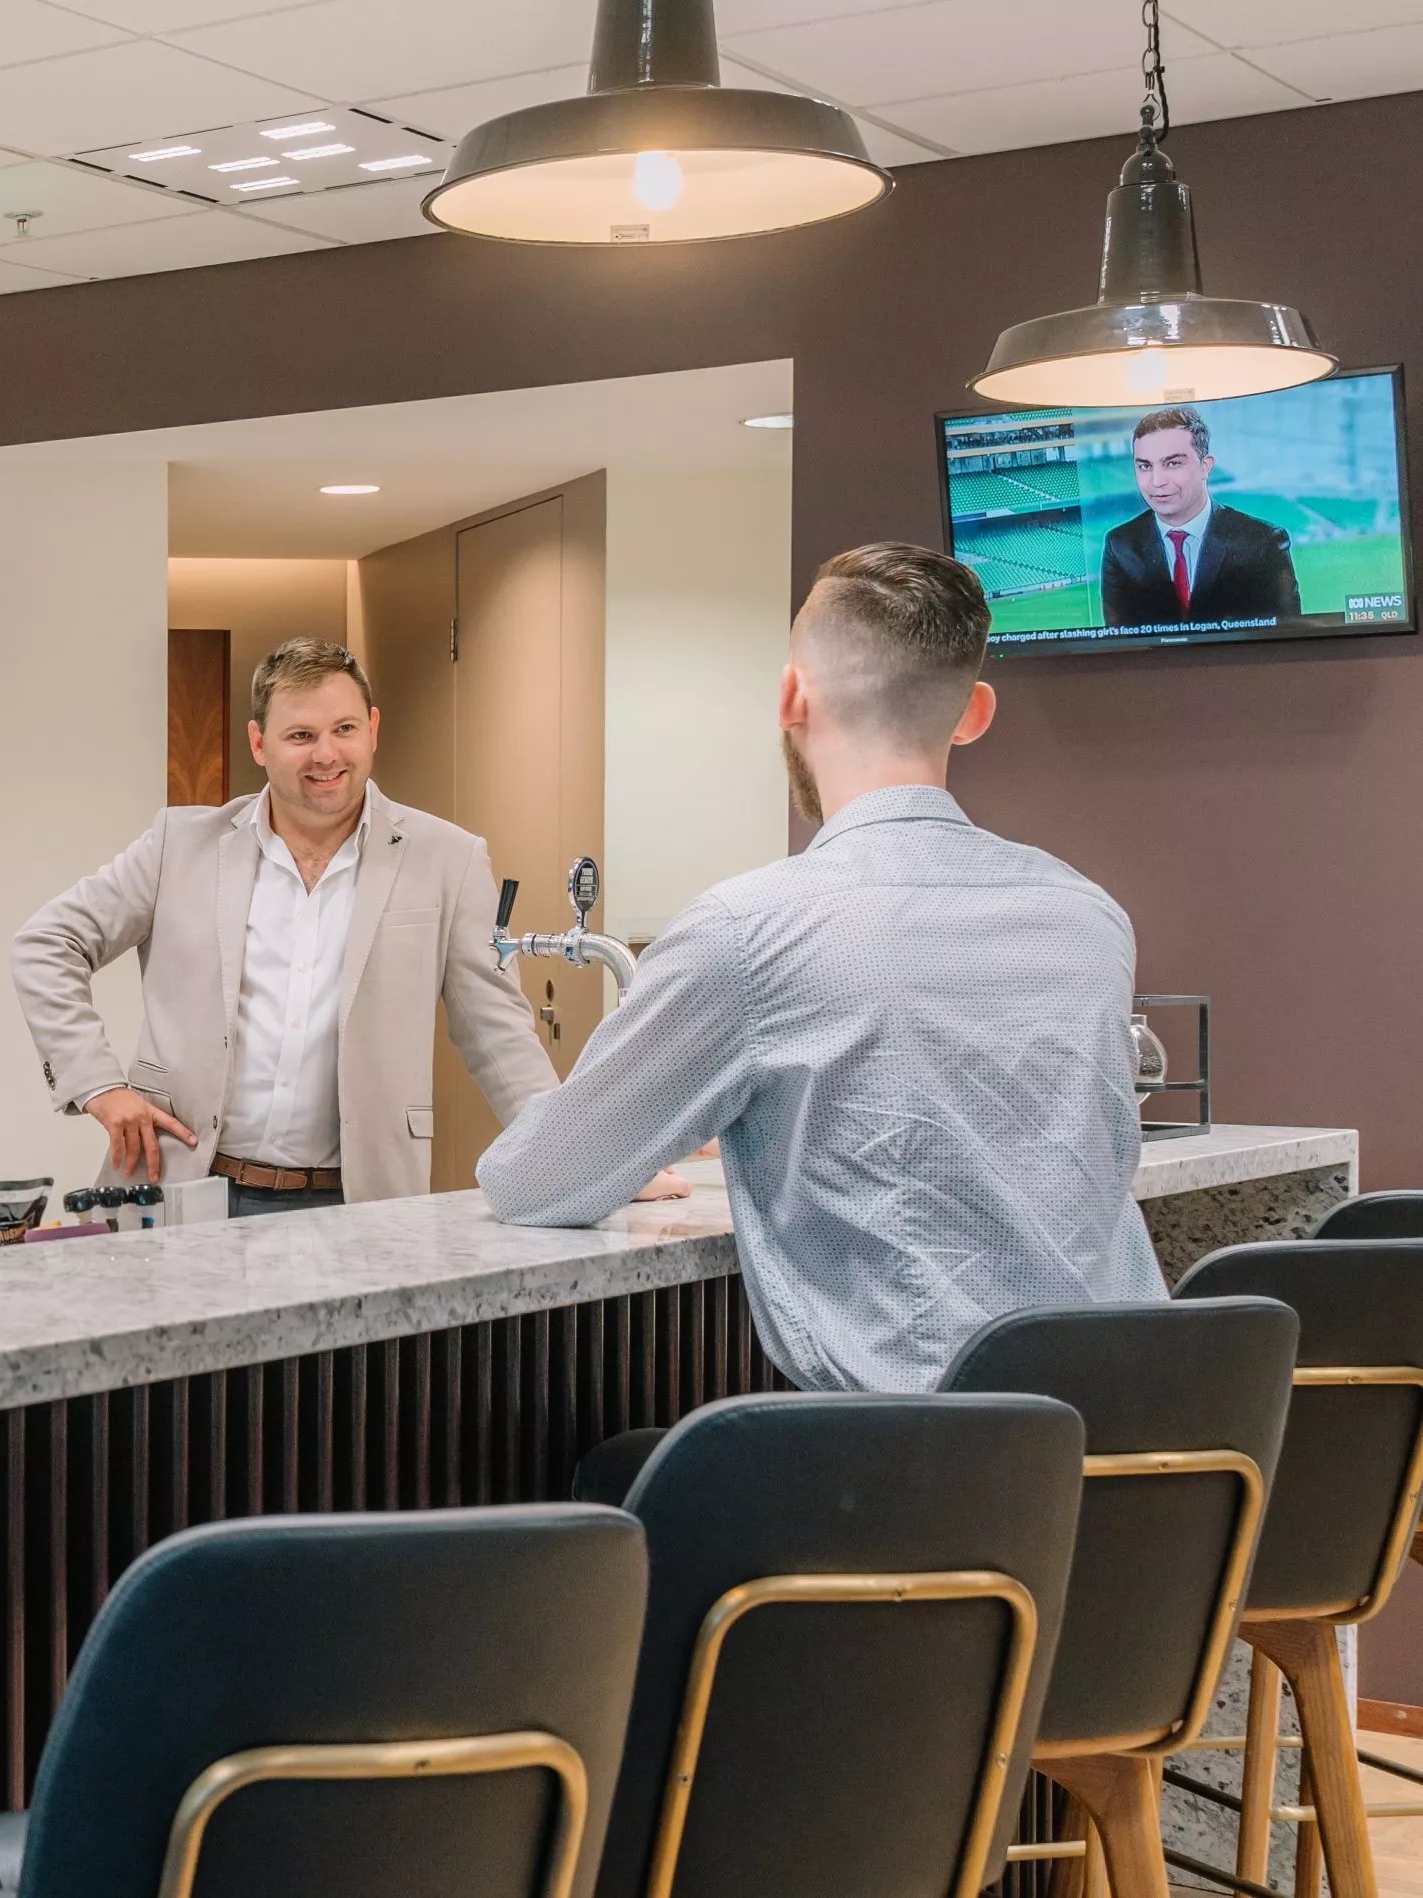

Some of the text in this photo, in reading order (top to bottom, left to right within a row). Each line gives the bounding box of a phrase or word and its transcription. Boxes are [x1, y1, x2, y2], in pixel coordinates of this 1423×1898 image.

[1365, 595, 1402, 608] NEWS
[1381, 610, 1398, 620] QLD
[1002, 631, 1037, 643] charged
[1037, 630, 1058, 641] after
[1059, 628, 1097, 641] slashing
[1097, 627, 1119, 638] girl's
[1120, 625, 1139, 635] face
[1140, 625, 1152, 634] 20
[1153, 623, 1179, 633] times
[1179, 622, 1189, 631] in
[1190, 620, 1221, 632] Logan,
[1221, 617, 1277, 630] Queensland
